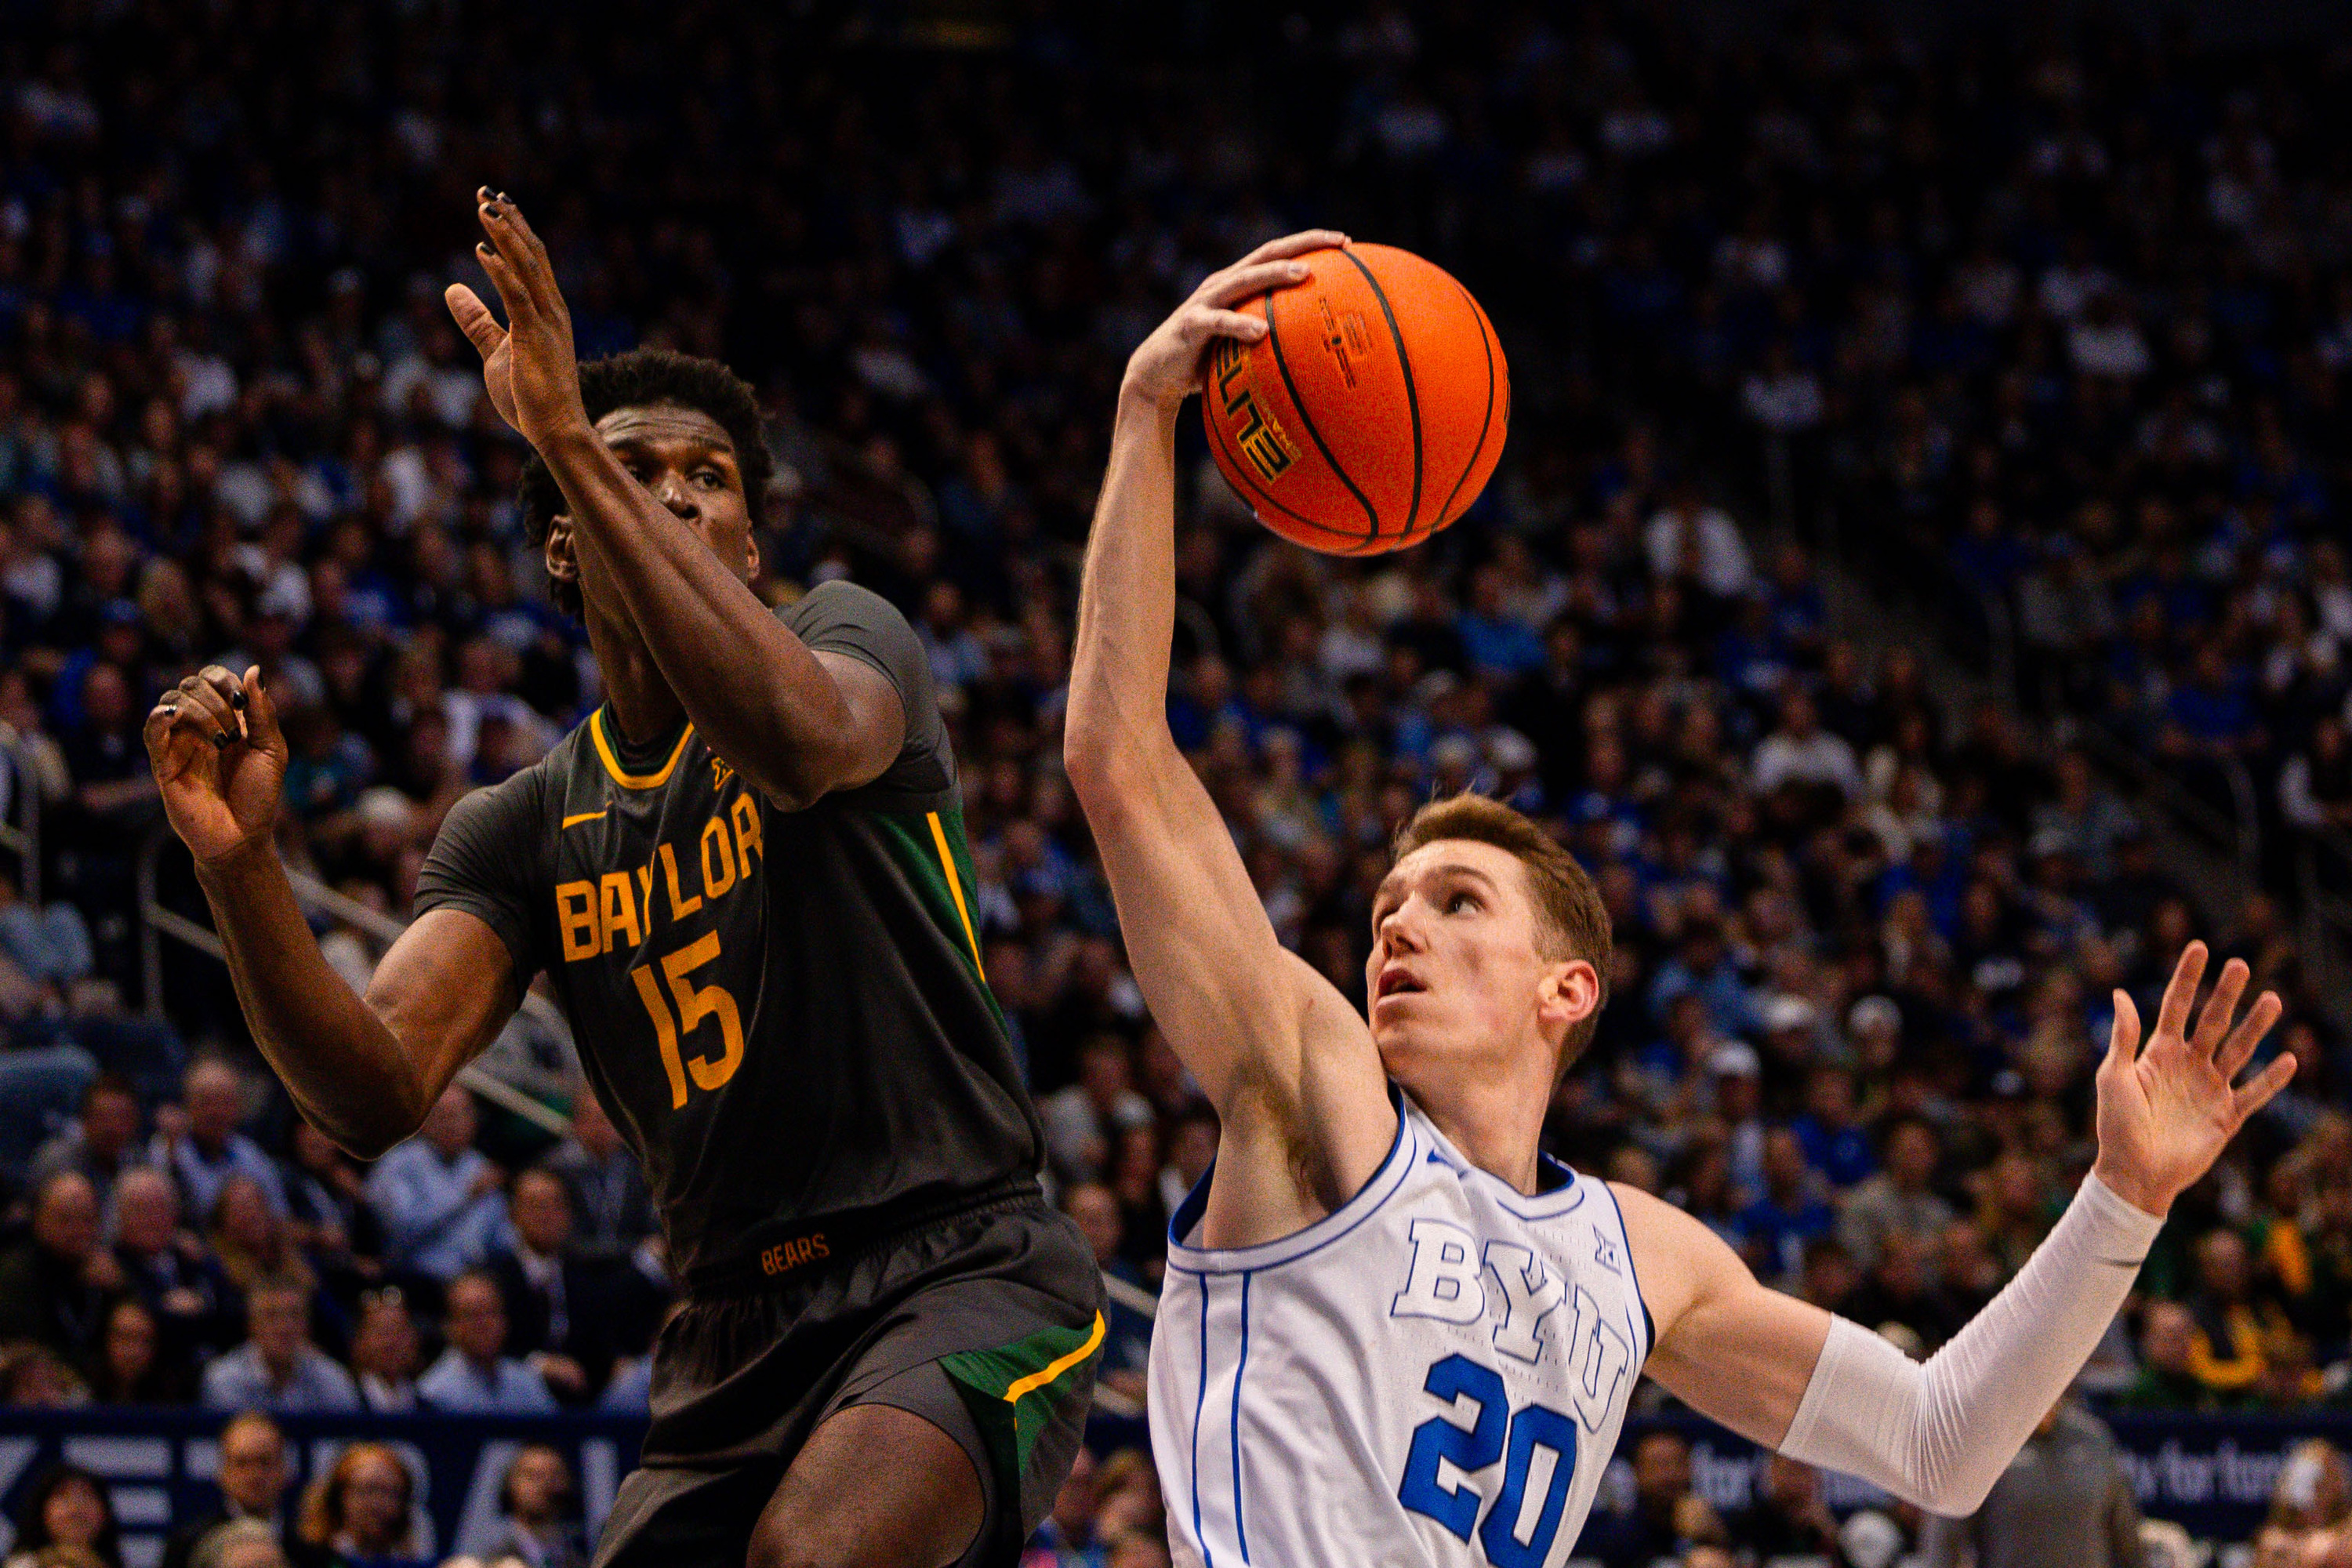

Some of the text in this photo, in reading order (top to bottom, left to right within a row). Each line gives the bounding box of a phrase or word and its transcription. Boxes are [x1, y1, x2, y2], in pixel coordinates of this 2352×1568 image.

[556, 791, 764, 963] BAYLOR
[631, 929, 745, 1110] 15
[760, 1232, 831, 1276] BEARS
[1390, 1216, 1630, 1434] BYU
[1398, 1352, 1578, 1568] 20
